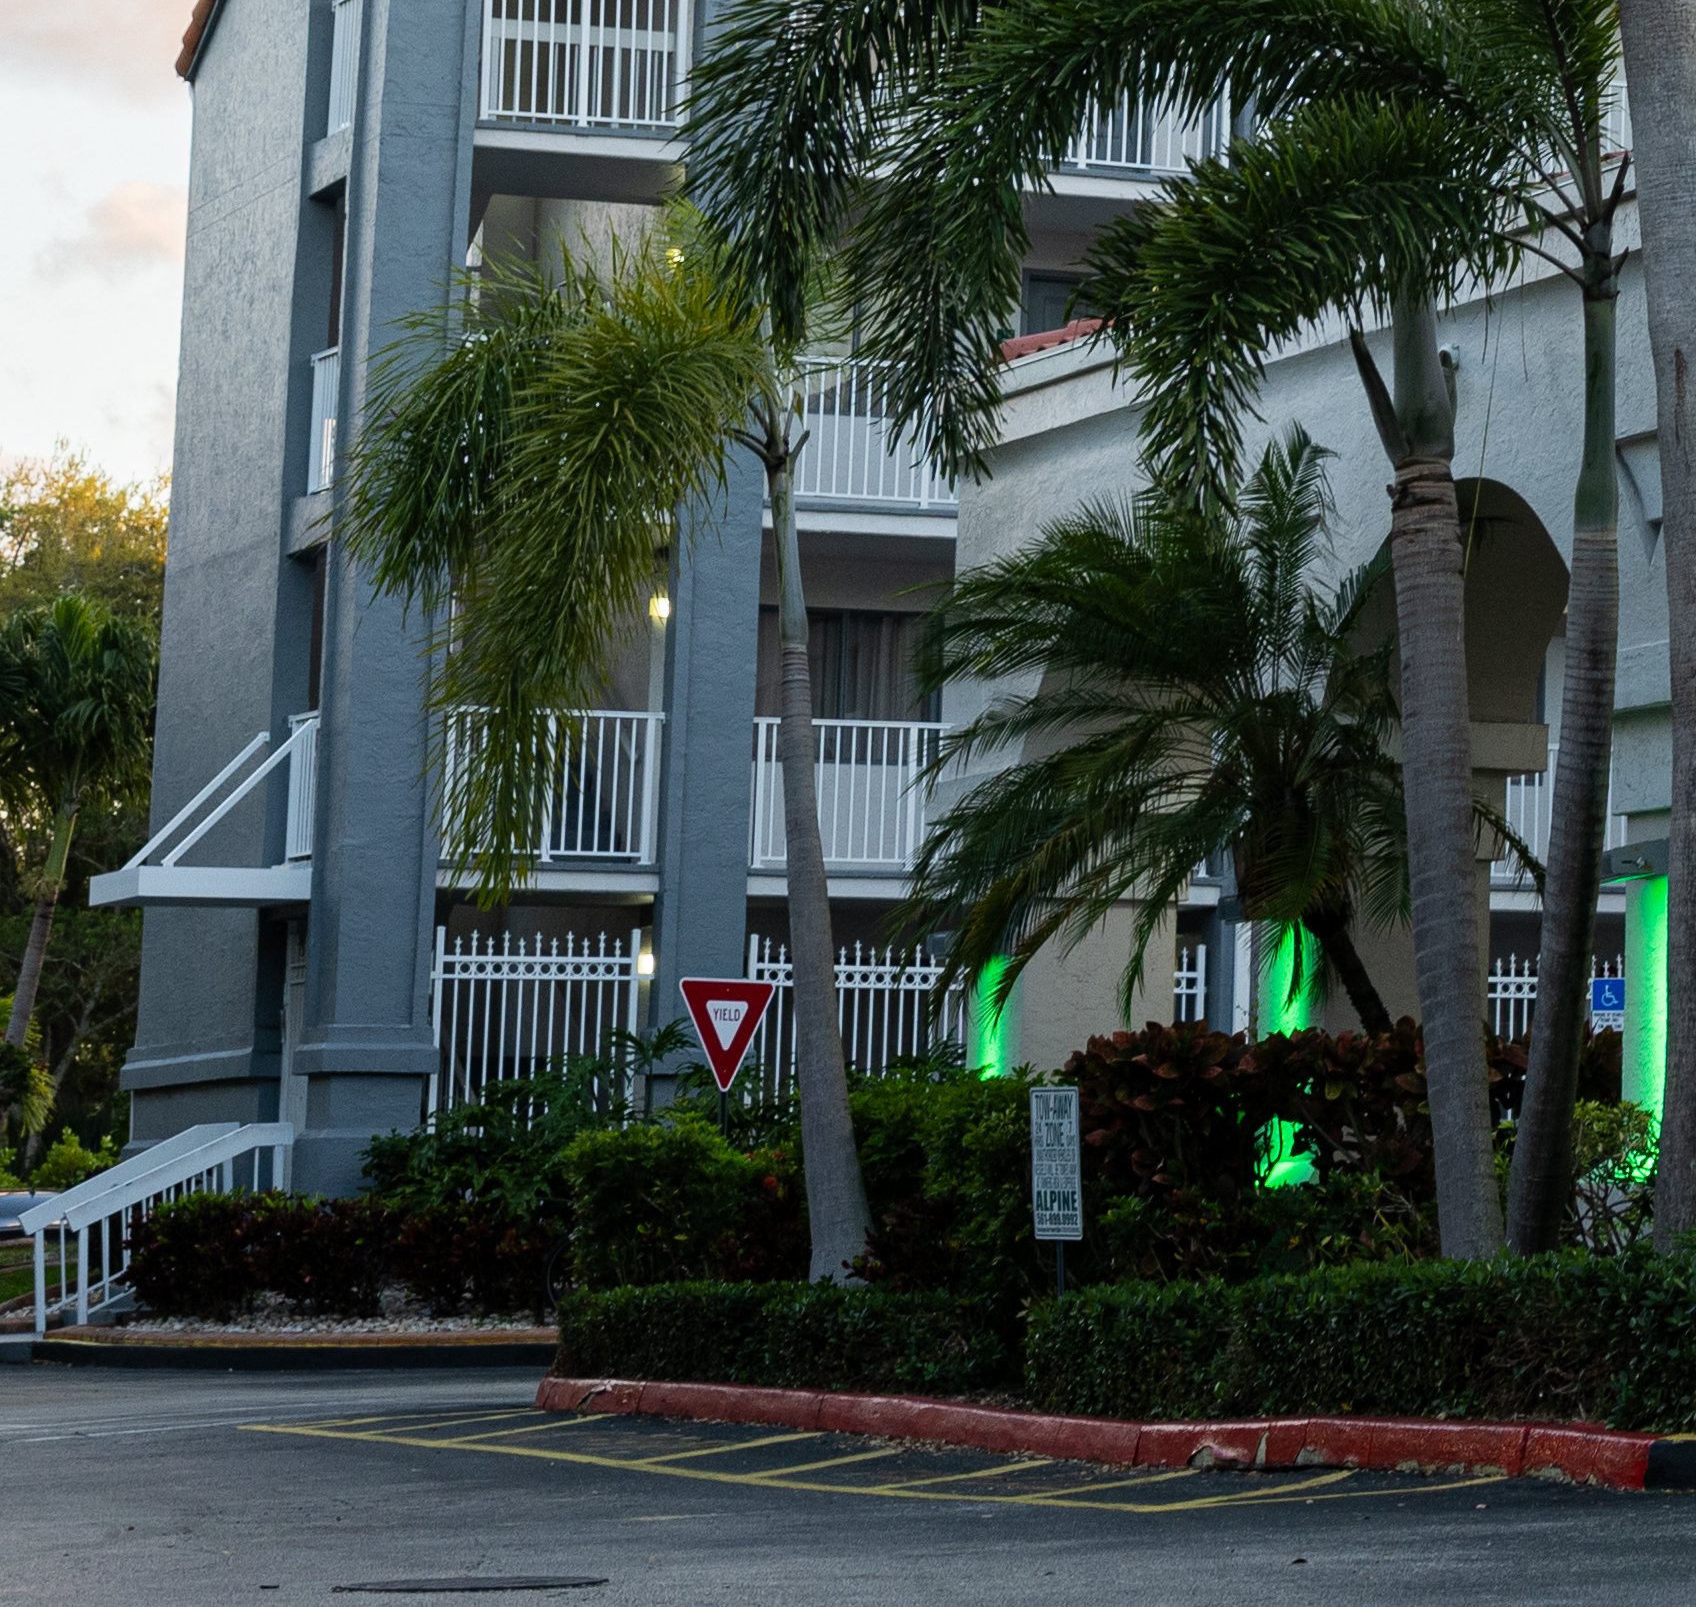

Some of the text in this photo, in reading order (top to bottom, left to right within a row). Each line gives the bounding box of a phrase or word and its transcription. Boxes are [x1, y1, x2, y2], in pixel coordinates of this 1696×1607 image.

[713, 1008, 740, 1022] YIELD
[1035, 1094, 1073, 1120] TOW-AWAY
[1045, 1122, 1065, 1147] ZONE
[1036, 1190, 1078, 1212] ALPINE
